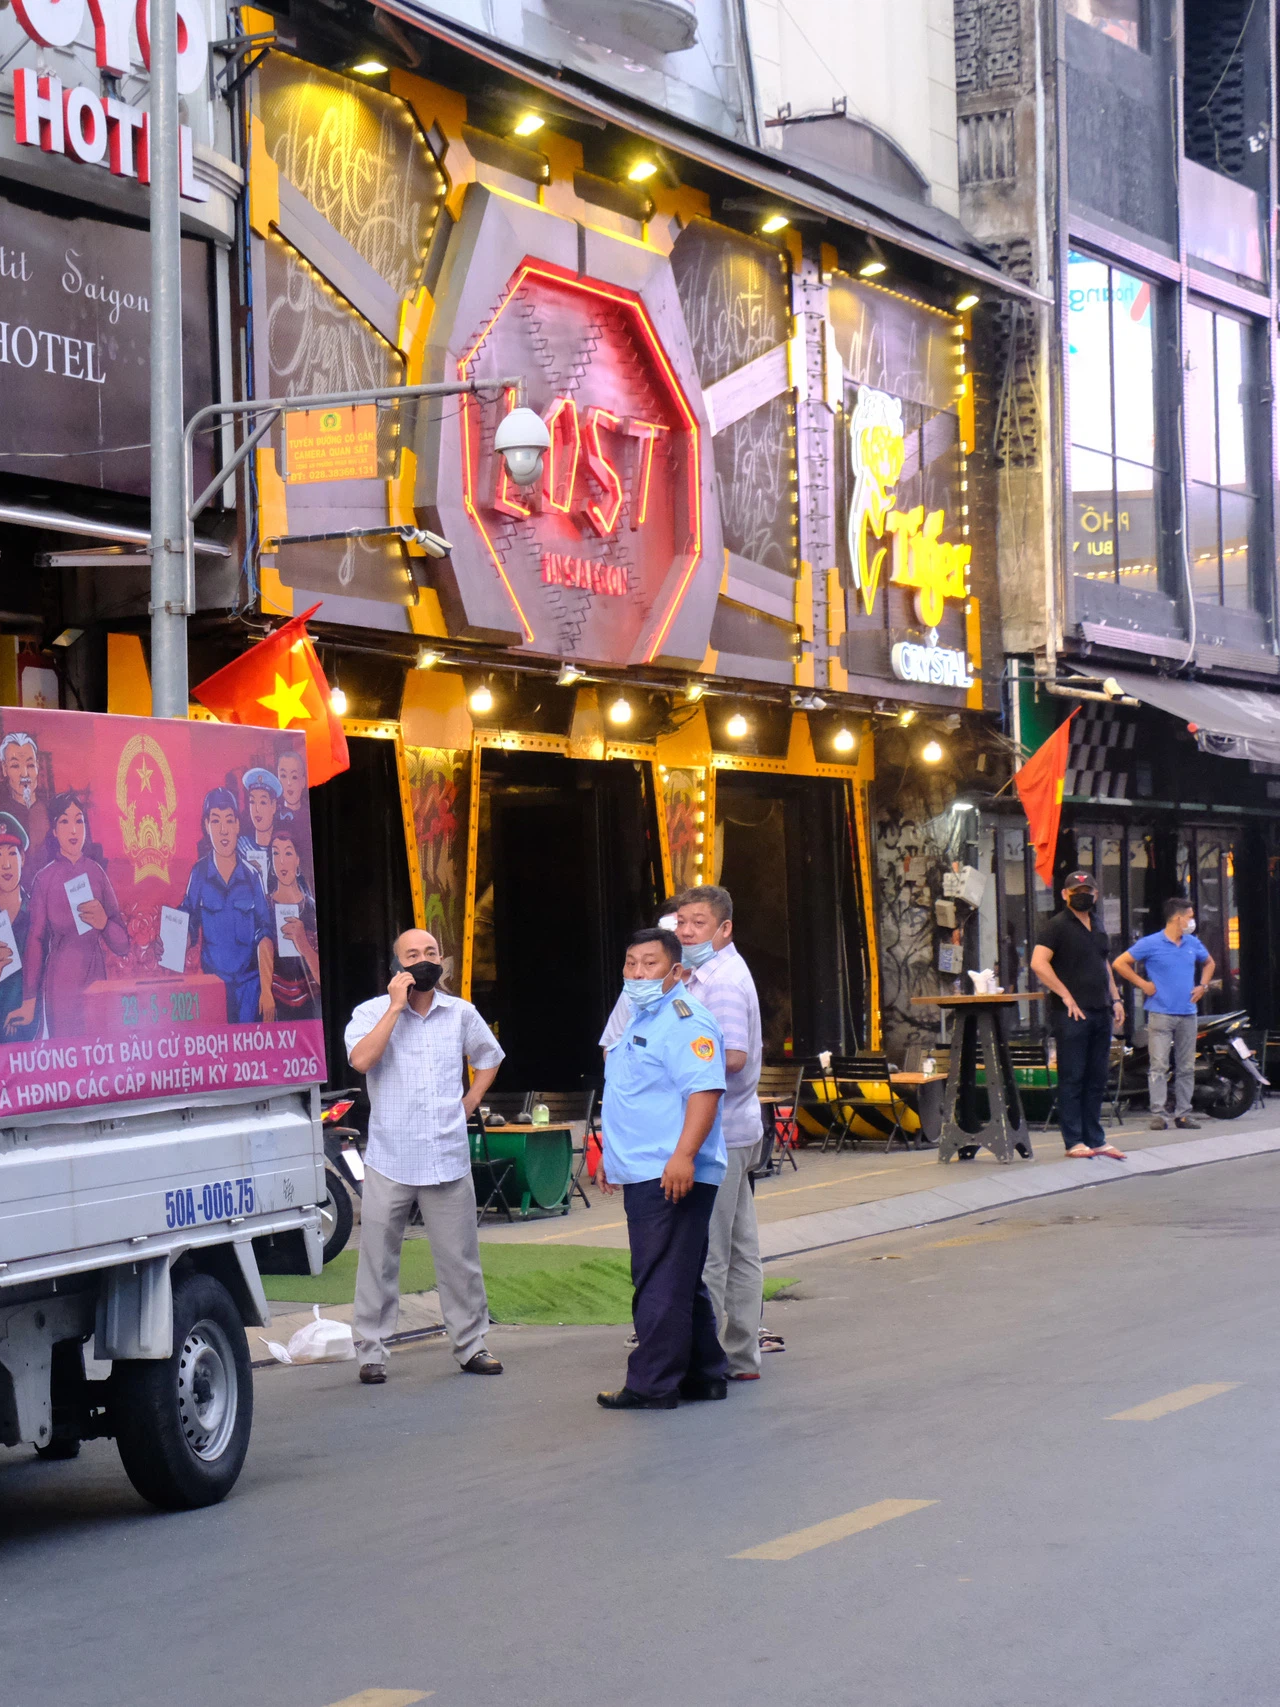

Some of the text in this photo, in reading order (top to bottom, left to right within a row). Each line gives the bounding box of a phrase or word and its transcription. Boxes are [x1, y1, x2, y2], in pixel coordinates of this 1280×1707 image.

[13, 67, 210, 203] HOTL
[62, 248, 151, 324] Saigon
[294, 448, 326, 460] CAMERA
[329, 446, 351, 457] QUAN
[491, 388, 670, 538] LOST
[885, 504, 972, 627] Tiger
[891, 640, 974, 689] CRYSTAL
[122, 995, 139, 1025] 23
[151, 994, 159, 1024] 5
[170, 992, 200, 1023] 2021
[9, 1025, 297, 1074] HƯỚNG TỚI BẦU CỬ ĐBQH KHÓA XV
[17, 1080, 71, 1107] HĐND
[76, 1070, 110, 1099] CÁC
[114, 1066, 146, 1095] CẤP
[151, 1061, 204, 1093] NHIỆM
[209, 1057, 228, 1085] KỲ
[233, 1060, 269, 1082] 2021
[282, 1056, 318, 1078] 2026
[165, 1177, 255, 1229] 50A-006.75
